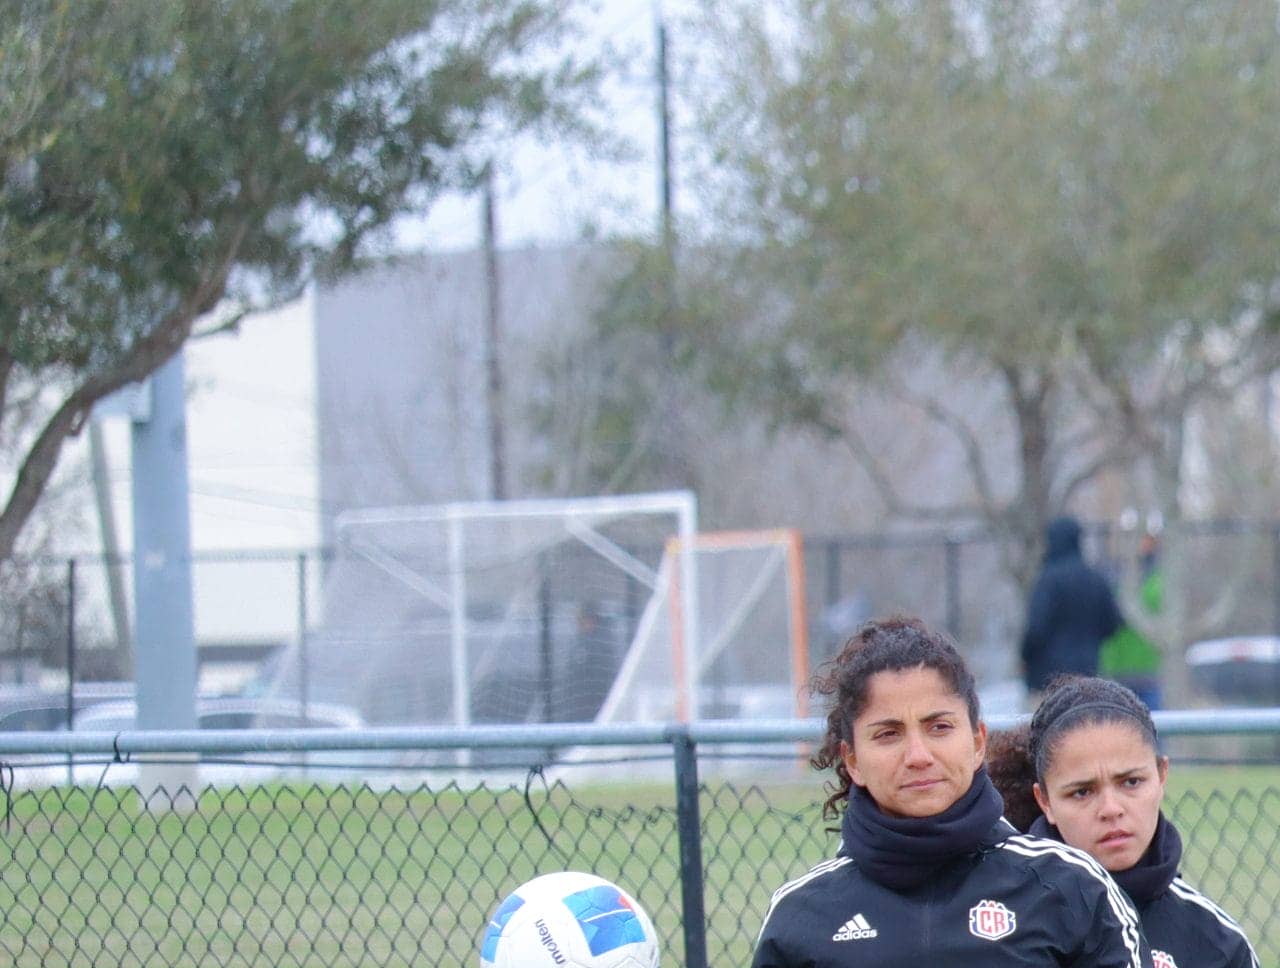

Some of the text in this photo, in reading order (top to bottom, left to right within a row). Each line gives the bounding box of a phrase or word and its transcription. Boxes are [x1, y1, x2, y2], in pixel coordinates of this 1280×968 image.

[979, 910, 1006, 933] CR
[535, 918, 566, 965] molten
[832, 928, 877, 942] adidas
